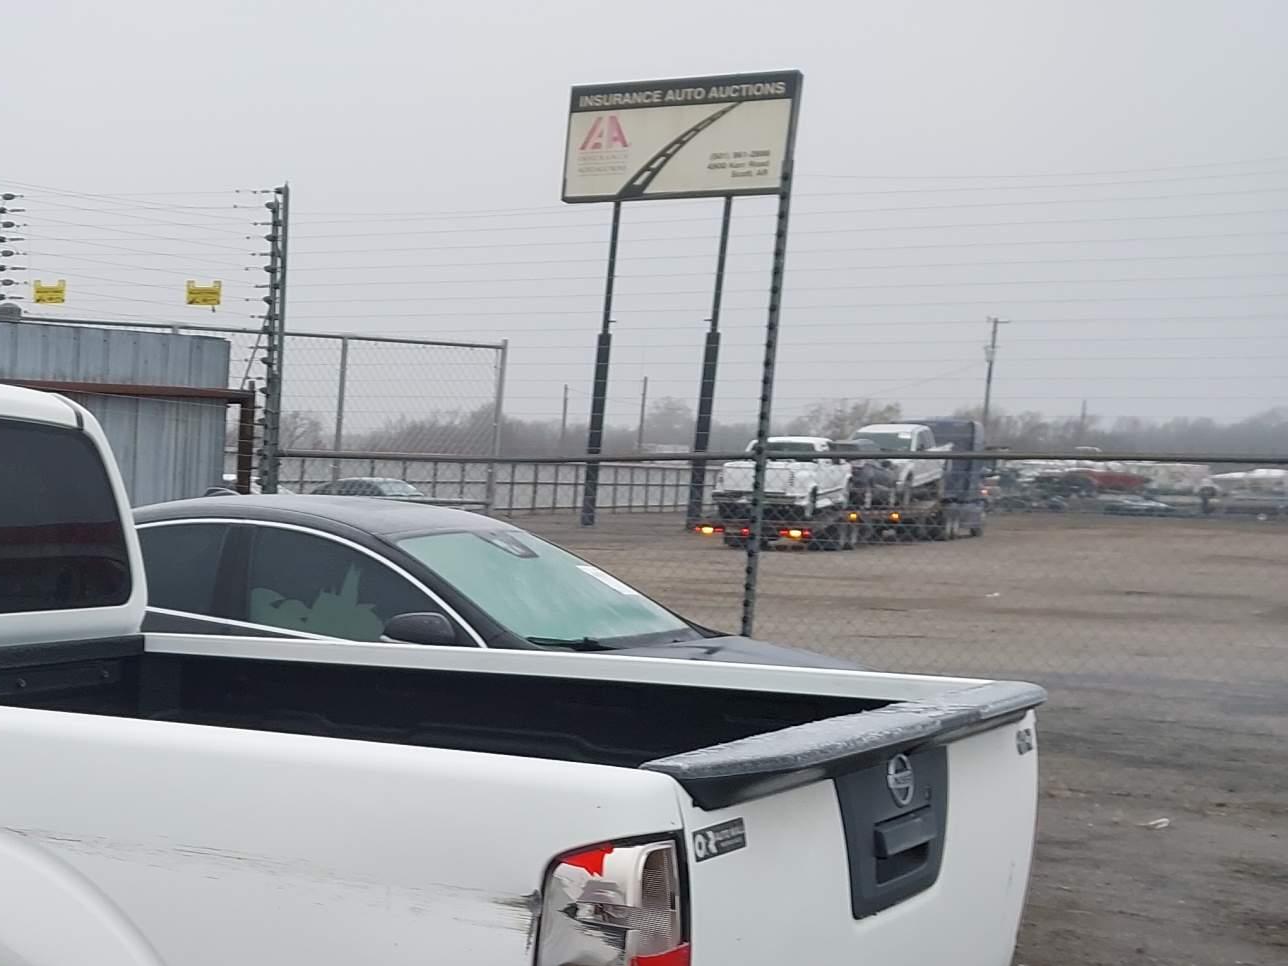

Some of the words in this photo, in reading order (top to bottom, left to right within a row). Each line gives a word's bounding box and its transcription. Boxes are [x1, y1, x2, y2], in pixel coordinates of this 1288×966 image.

[579, 90, 663, 107] INSURANCE
[664, 87, 706, 101] AUTO
[708, 81, 786, 98] AUCTIONS
